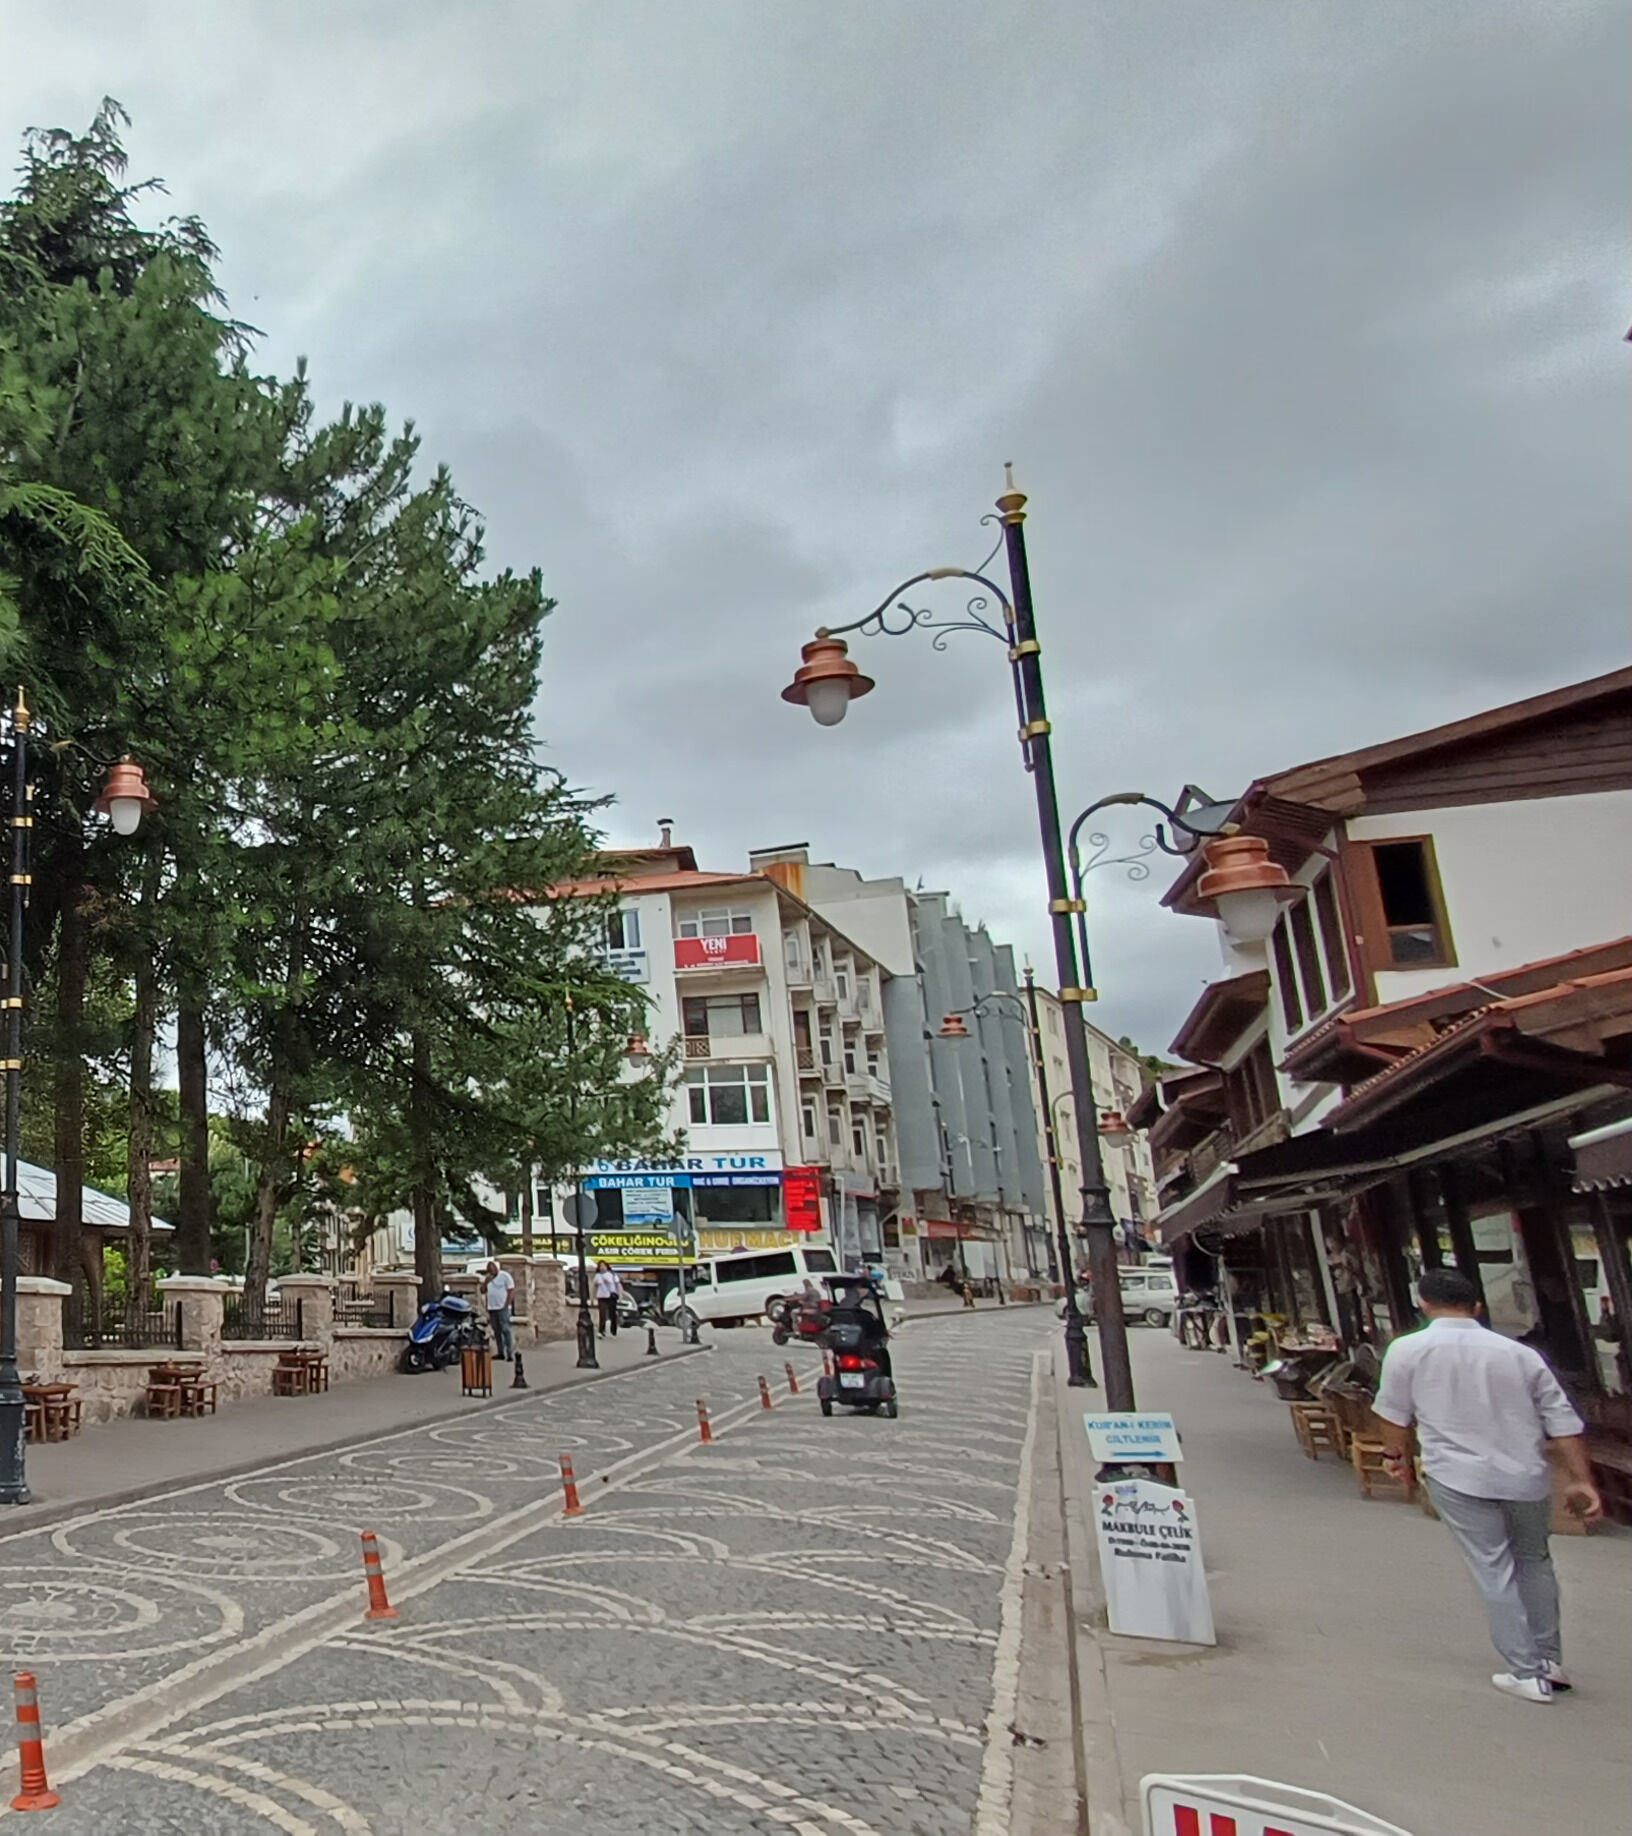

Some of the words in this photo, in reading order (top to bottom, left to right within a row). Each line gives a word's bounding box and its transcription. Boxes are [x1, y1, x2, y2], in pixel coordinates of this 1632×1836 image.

[614, 1158, 704, 1171] BAHAR
[712, 1157, 766, 1169] TUR
[598, 1177, 644, 1188] BAHAR
[647, 1176, 674, 1187] TUR
[1102, 1521, 1156, 1536] MAKBULE
